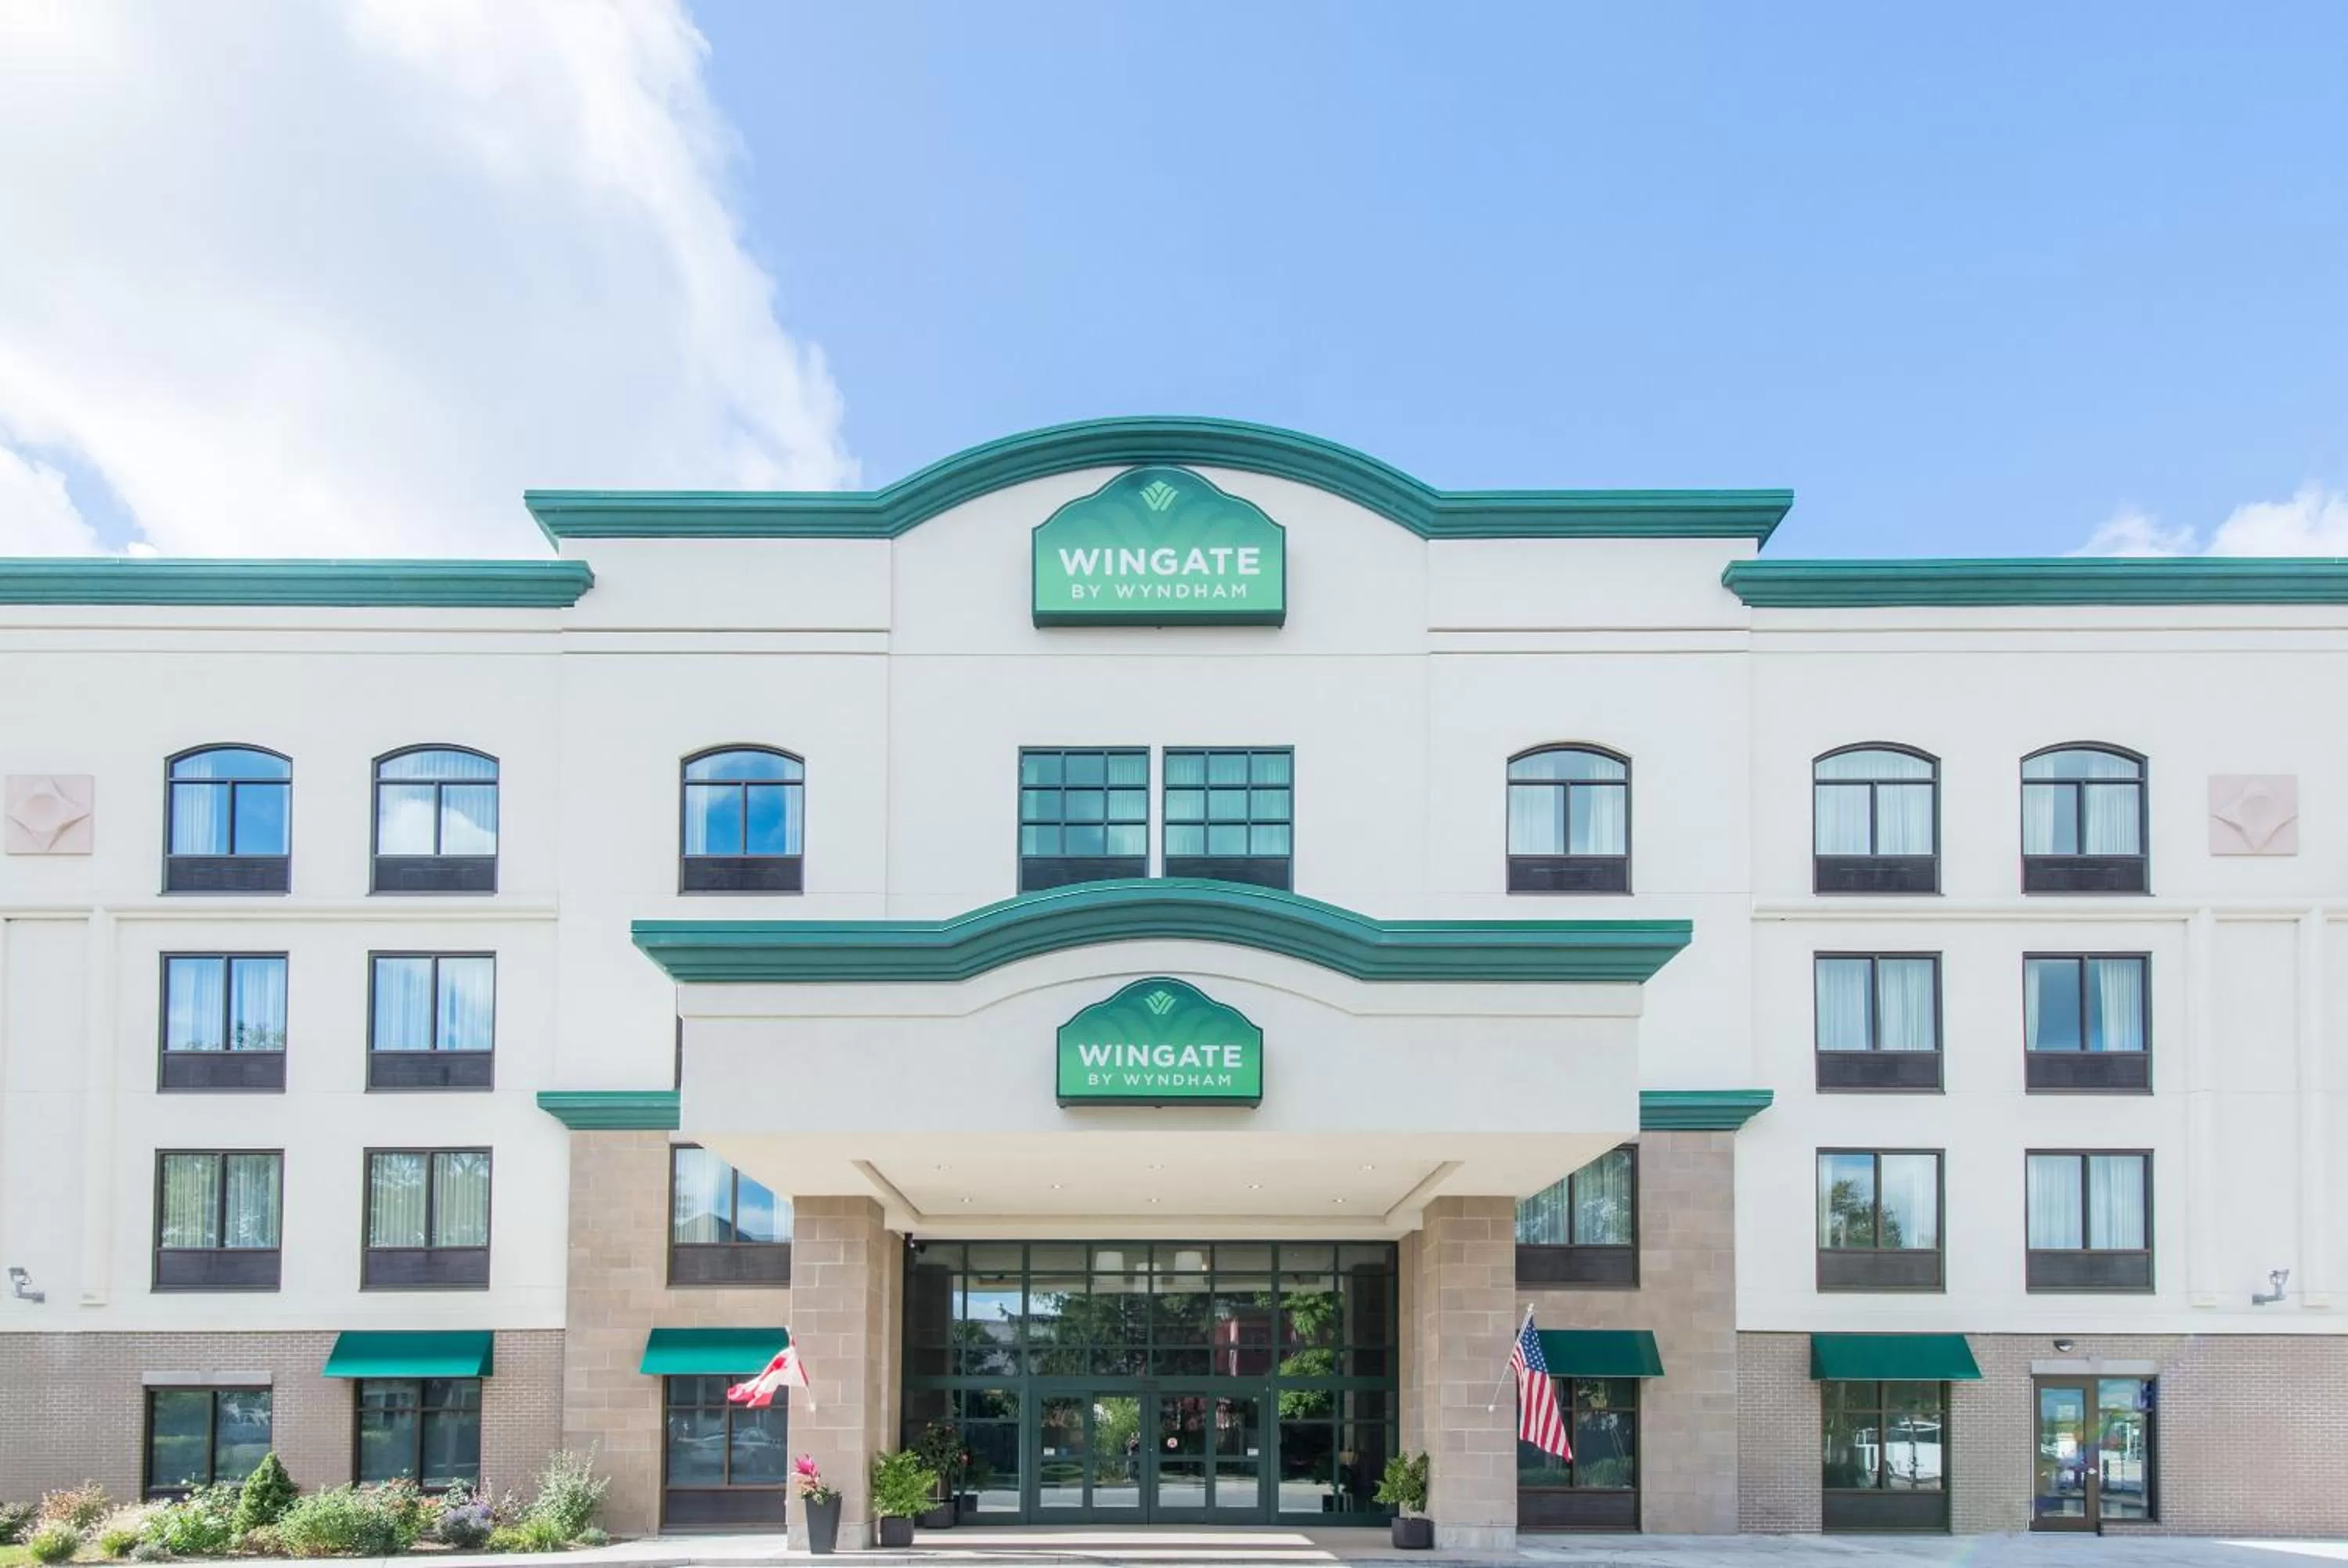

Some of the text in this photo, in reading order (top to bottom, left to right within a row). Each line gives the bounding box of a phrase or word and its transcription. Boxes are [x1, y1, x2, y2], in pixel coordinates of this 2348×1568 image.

[1058, 548, 1261, 575] WINGATE
[1071, 584, 1248, 599] BY WYNDHAM
[1079, 1045, 1243, 1067] WINGATE
[1089, 1074, 1231, 1086] BY WYNDHAM
